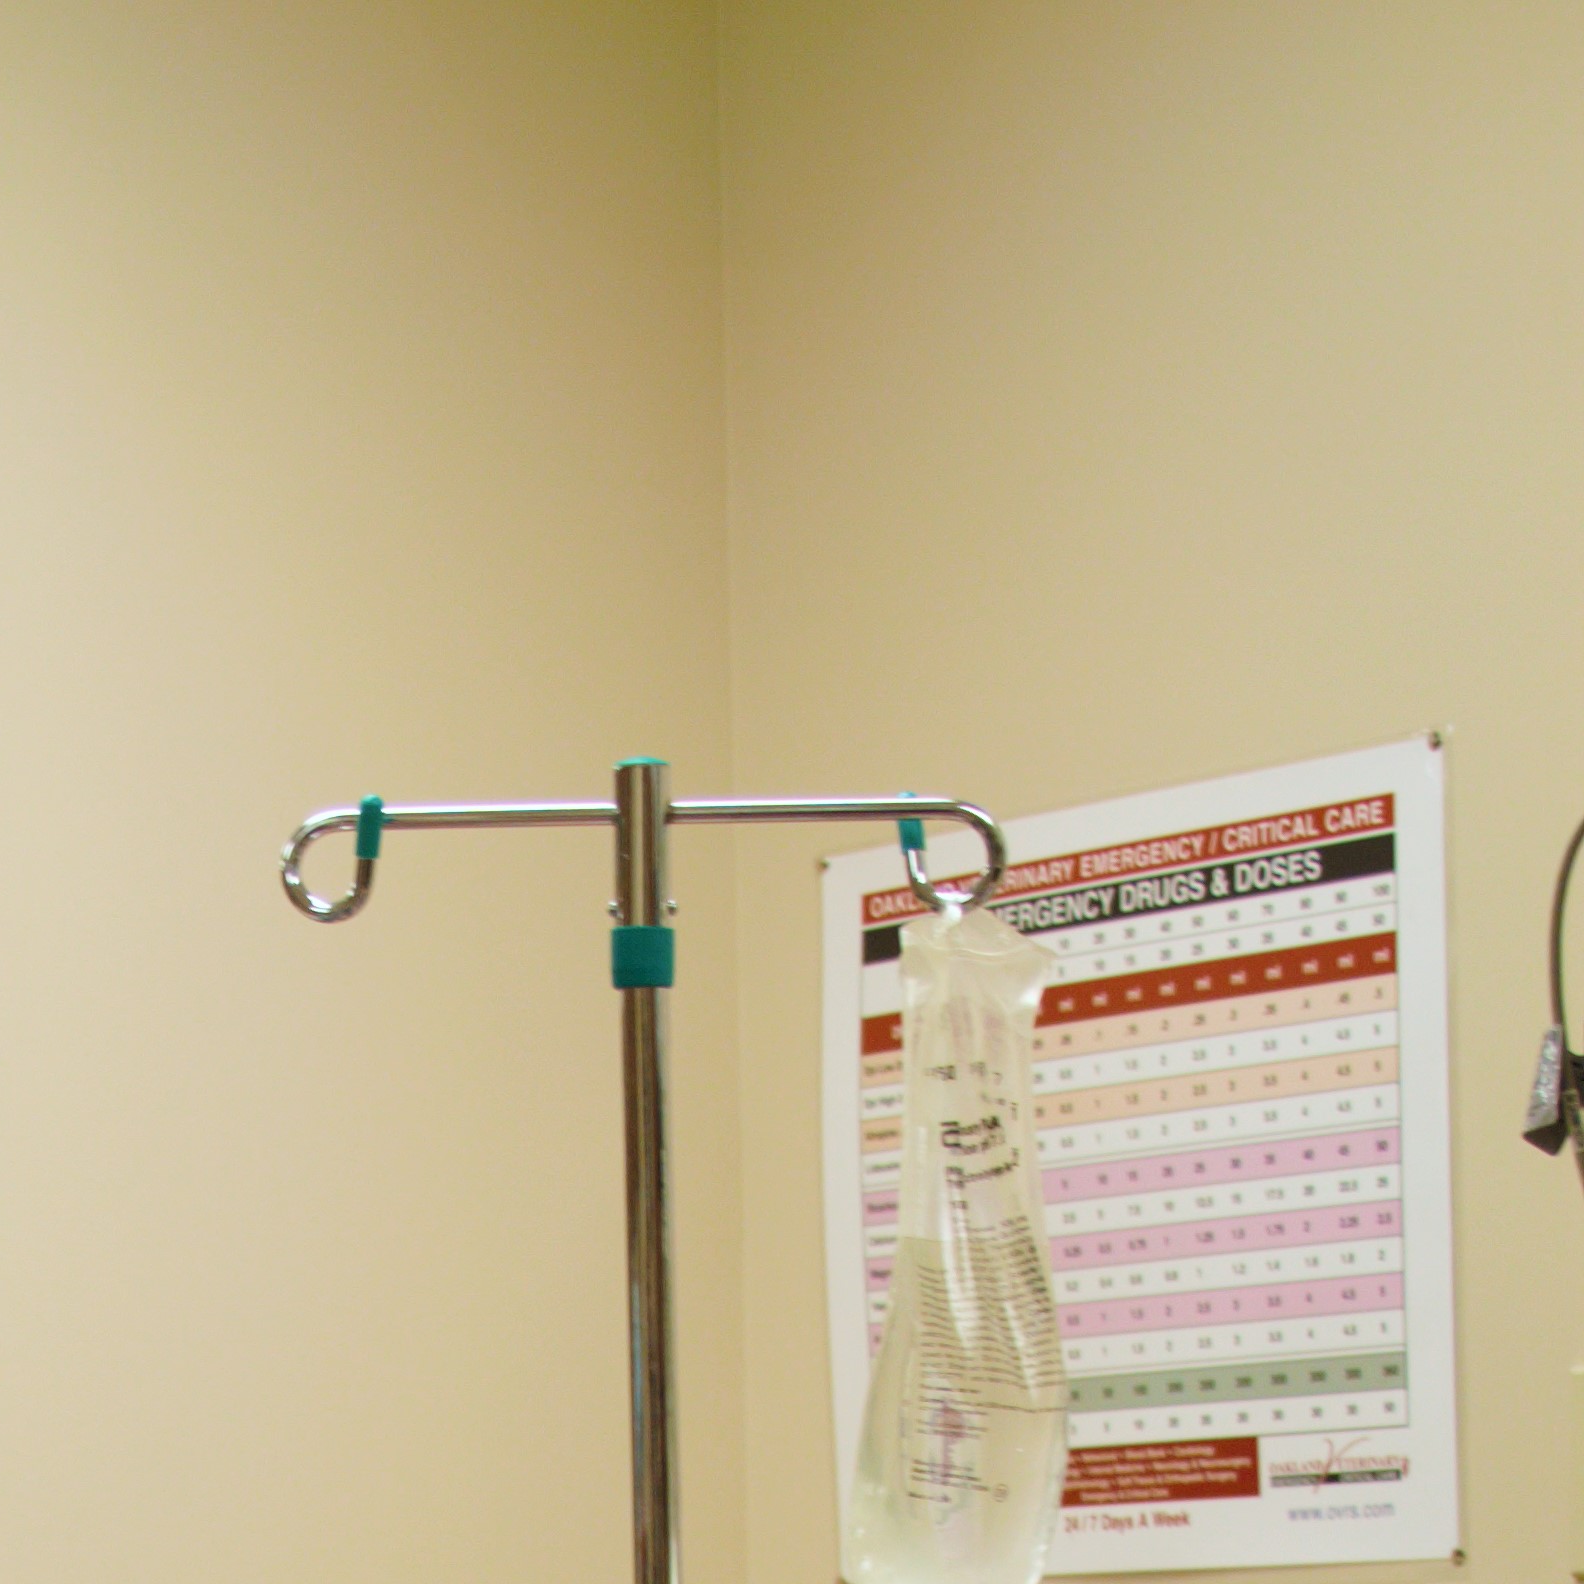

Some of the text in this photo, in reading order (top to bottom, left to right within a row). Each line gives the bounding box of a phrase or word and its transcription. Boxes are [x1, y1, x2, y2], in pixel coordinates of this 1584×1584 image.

[1079, 835, 1206, 878] EMERGENCY
[1208, 832, 1217, 855] /
[1222, 814, 1319, 851] CRITICAL
[1324, 800, 1384, 833] CARE
[1119, 871, 1206, 914] DRUGS
[1209, 867, 1229, 898] &
[1233, 850, 1323, 893] DOSES
